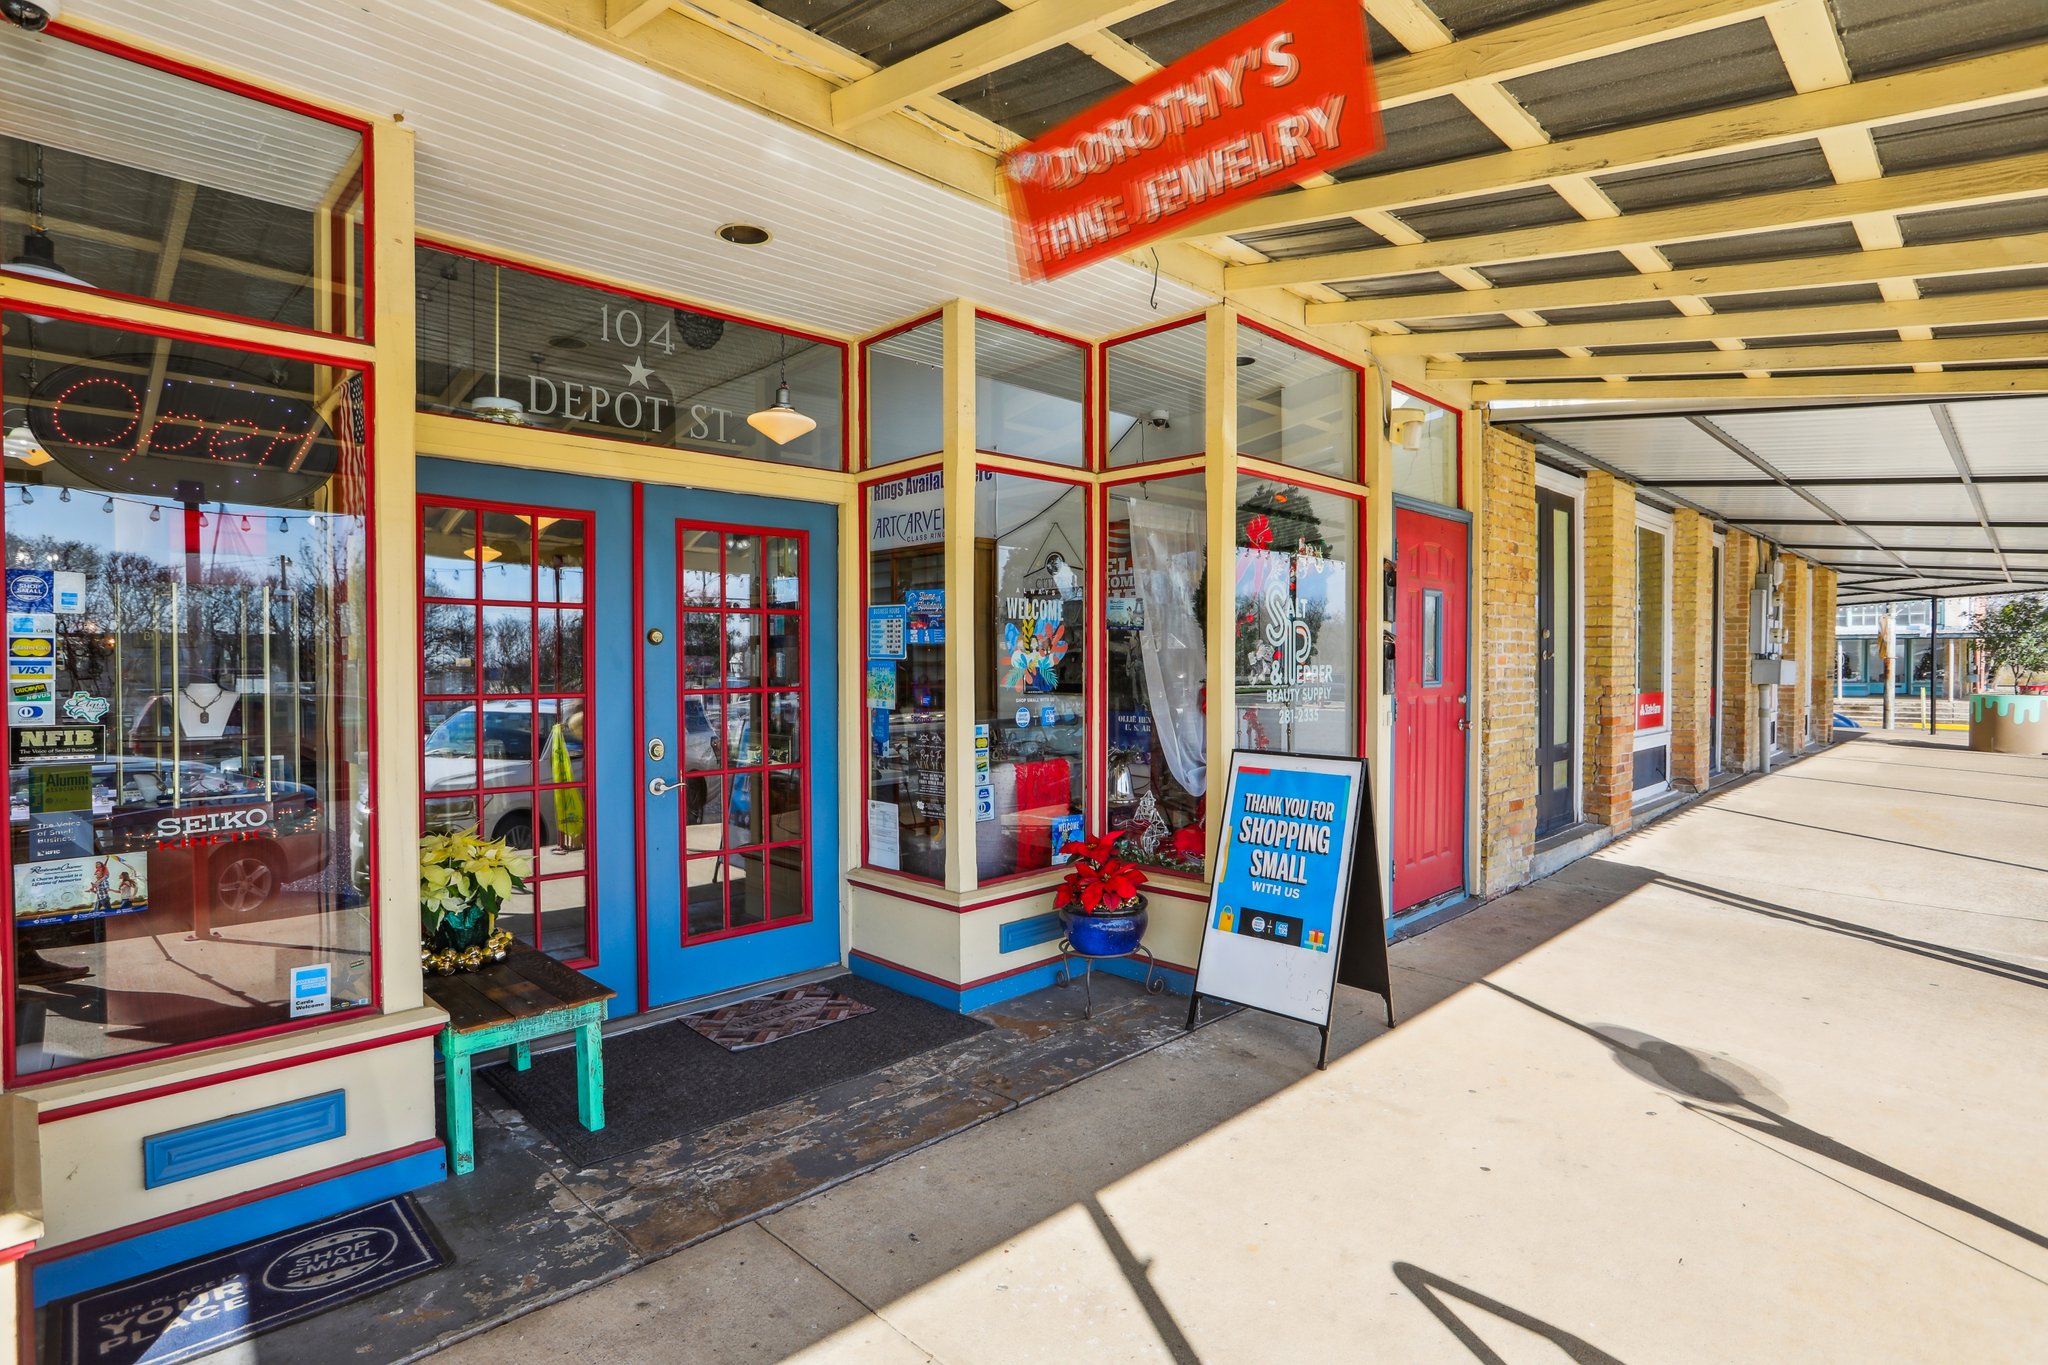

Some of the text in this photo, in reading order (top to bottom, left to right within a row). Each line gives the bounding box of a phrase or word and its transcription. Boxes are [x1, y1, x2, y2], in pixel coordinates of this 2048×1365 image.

[1047, 31, 1300, 190] DOROTHY'S
[1028, 94, 1347, 263] FINE JEWELRY
[600, 303, 676, 356] 104
[528, 374, 737, 444] DEPOT ST.
[52, 377, 317, 472] Open
[873, 481, 904, 502] Rings
[873, 506, 945, 541] ARTCARVE
[907, 534, 928, 543] CLASS
[1016, 587, 1056, 596] ALWAYS
[1006, 597, 1065, 621] WELCOME
[18, 666, 46, 674] VISA
[1266, 686, 1332, 703] BEAUTY SUPPLY
[1118, 715, 1137, 723] OLLIE
[1278, 708, 1319, 725] 281-2335
[20, 730, 95, 747] NFIB
[46, 774, 89, 787] Alumni
[1245, 793, 1335, 822] THANK YOU FOR
[37, 829, 47, 837] of
[157, 808, 268, 838] SEIKO
[1238, 815, 1331, 855] SHOPPING
[37, 835, 77, 844] Business
[158, 828, 273, 852] KINETIC
[1249, 849, 1308, 885] SMALL
[1251, 881, 1301, 899] WITH US
[295, 1002, 325, 1011] Welcome
[286, 1247, 378, 1280] SMALL
[294, 1240, 371, 1268] SHOP
[98, 1303, 144, 1324] OUR
[151, 1279, 215, 1307] PLACE
[101, 1280, 246, 1336] YOUR
[99, 1293, 250, 1355] PLACE
